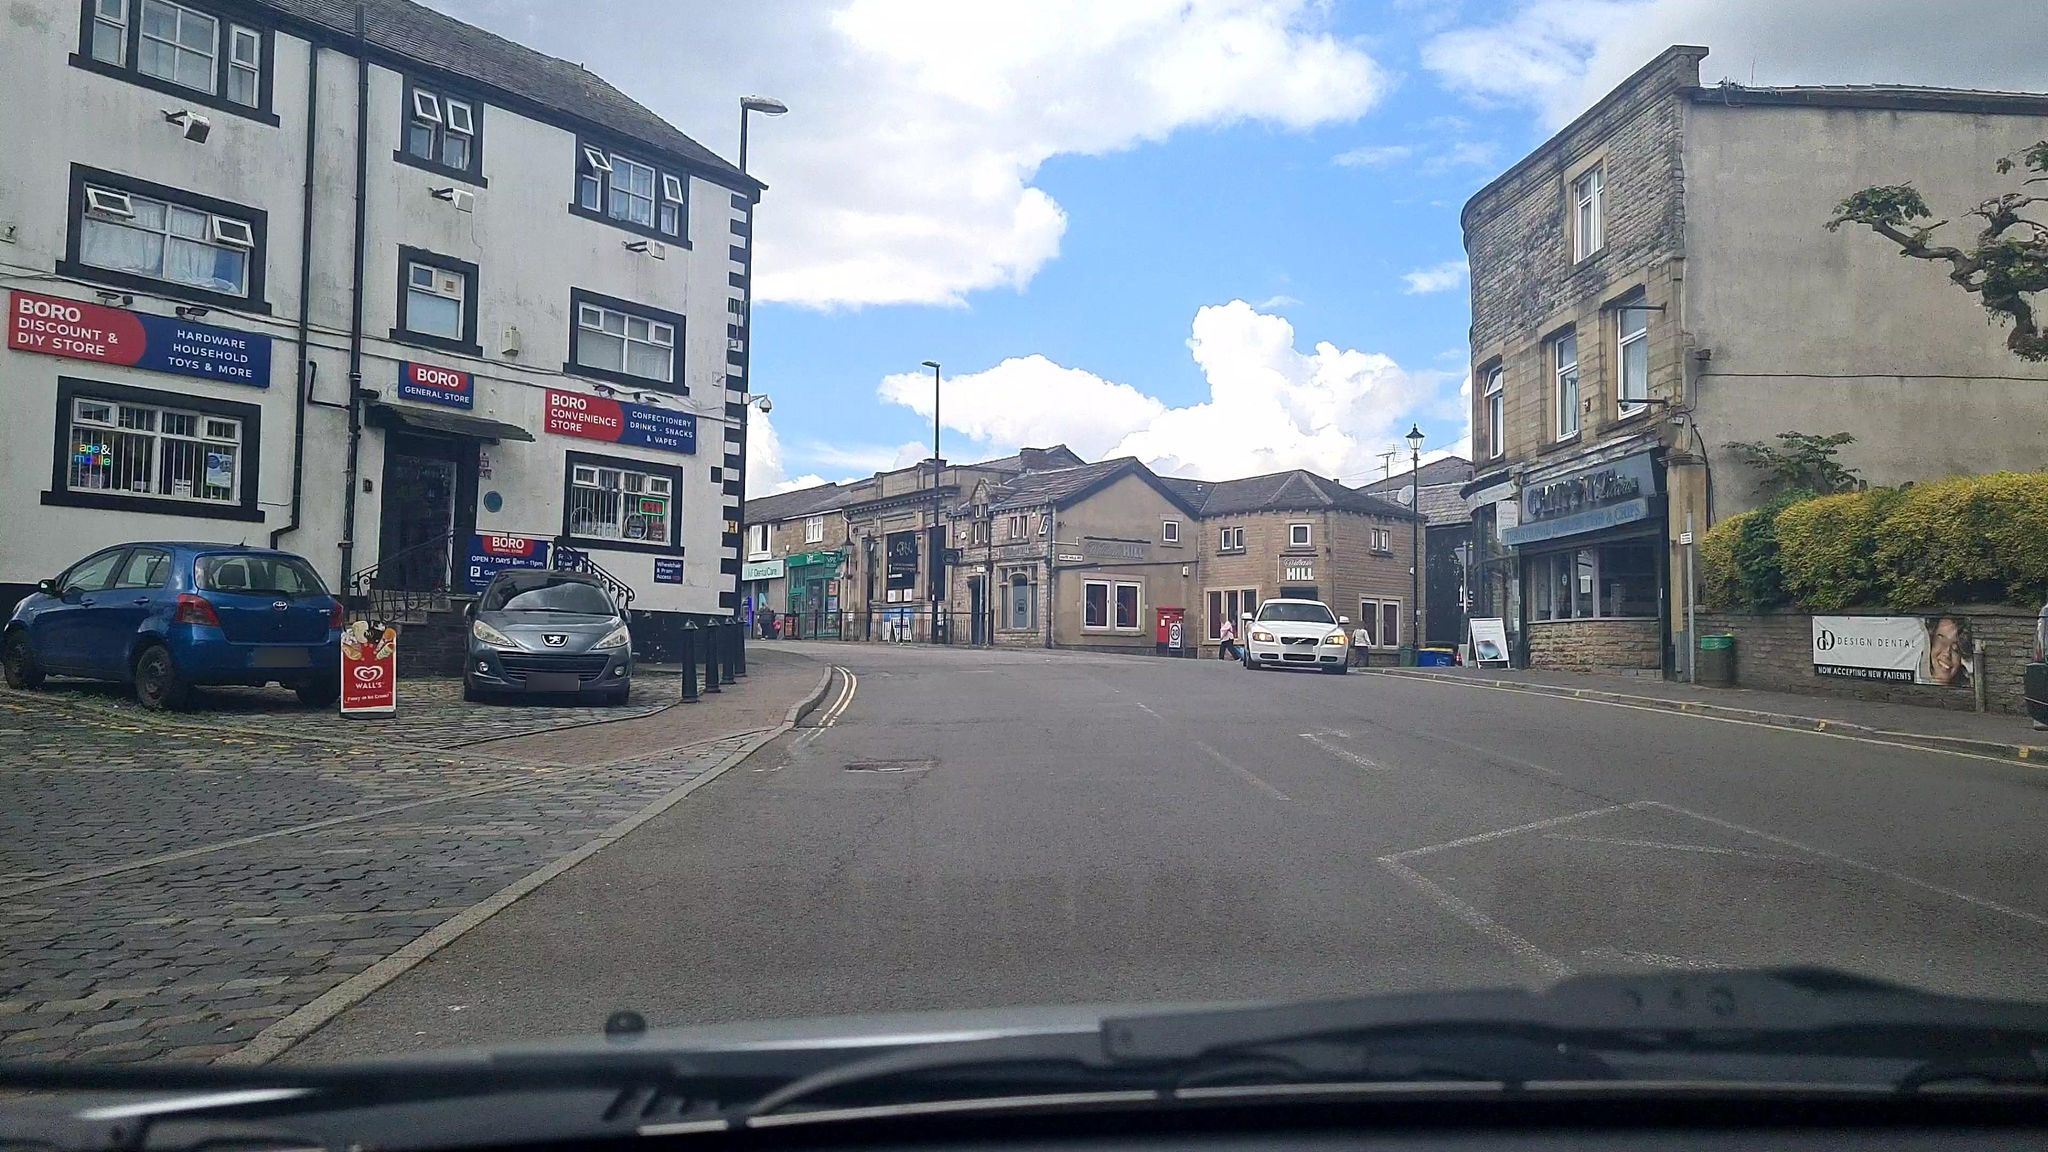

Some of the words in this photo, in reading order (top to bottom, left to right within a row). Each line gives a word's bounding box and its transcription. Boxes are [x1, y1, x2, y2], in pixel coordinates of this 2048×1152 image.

[20, 298, 81, 322] BORO
[19, 317, 102, 340] DISCOUNT
[108, 333, 118, 344] &
[18, 332, 45, 345] DIY
[53, 338, 105, 355] STORE
[177, 329, 246, 349] HARDWARE
[173, 343, 248, 363] HOUSEHOLD
[168, 357, 199, 369] TOYS
[205, 363, 212, 371] &
[219, 365, 252, 378] MORE
[417, 368, 459, 387] BORO
[405, 386, 442, 398] GENERAL
[444, 393, 470, 403] STORE
[551, 394, 587, 410] BORO
[551, 409, 617, 427] CONVENIENCE
[551, 420, 582, 432] STORE
[632, 411, 692, 427] CONFECTIONERY
[630, 422, 657, 432] DRINKS
[665, 427, 693, 438] SNACKS
[655, 436, 677, 446] VAPES
[100, 444, 111, 455] &
[492, 536, 525, 549] BORO
[471, 555, 489, 563] OPEN
[529, 559, 544, 568] 11pm
[657, 561, 681, 569] Wheelchair
[1286, 567, 1314, 580] HILL
[1837, 636, 1872, 647] DESIGN
[1877, 638, 1915, 648] DENTAL
[1818, 666, 1832, 674] NOW
[1833, 668, 1867, 677] ACCEPTING
[1867, 669, 1882, 678] NEW
[1883, 671, 1911, 681] PATIENTS
